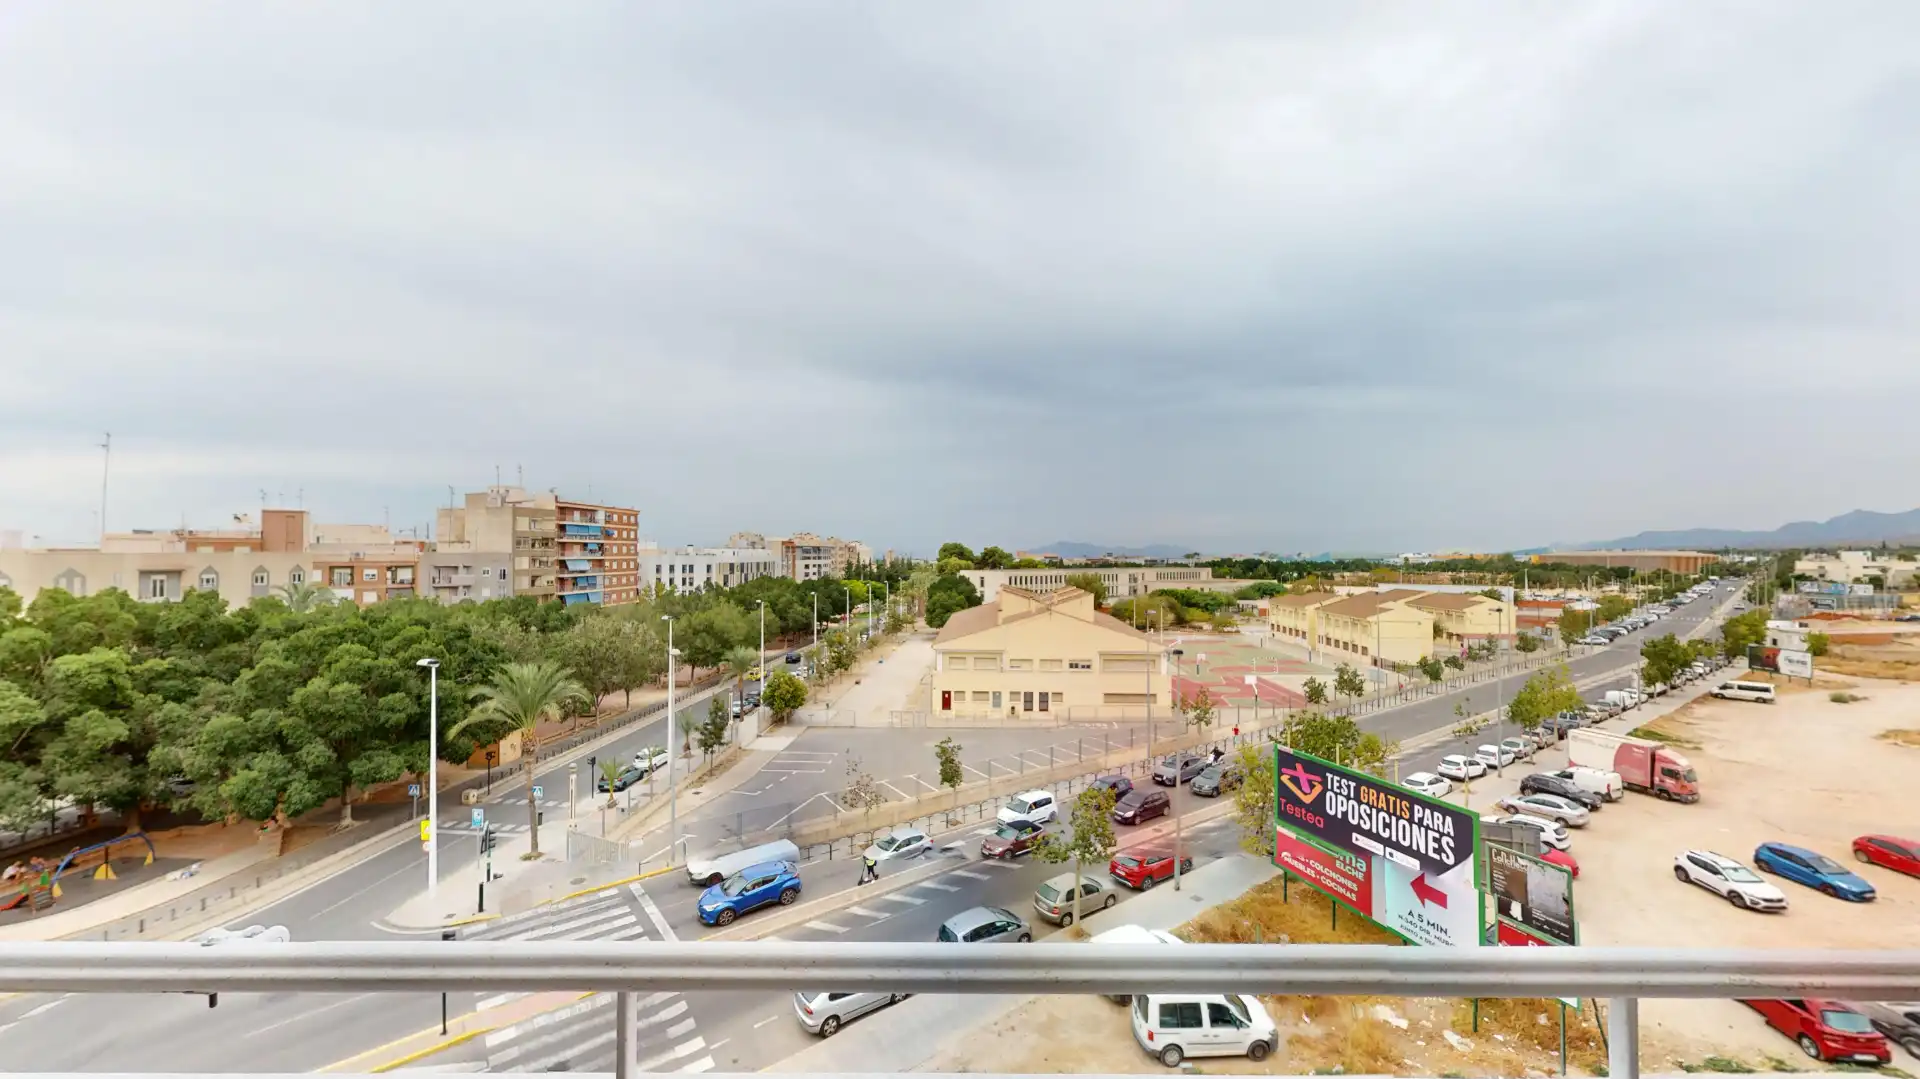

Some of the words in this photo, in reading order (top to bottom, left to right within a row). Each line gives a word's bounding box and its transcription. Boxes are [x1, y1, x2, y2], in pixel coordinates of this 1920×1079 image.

[1280, 798, 1324, 829] Testea
[1325, 772, 1356, 799] TEST
[1360, 786, 1410, 819] GRATIS
[1413, 804, 1455, 837] PARA
[1325, 790, 1455, 866] OPOSICIONES
[1309, 859, 1358, 892] COLCHONES
[1335, 860, 1365, 881] ELCHE
[1320, 875, 1357, 902] COCINAS
[1407, 909, 1415, 919] A
[1417, 913, 1424, 923] 5
[1427, 918, 1451, 938] MIN.
